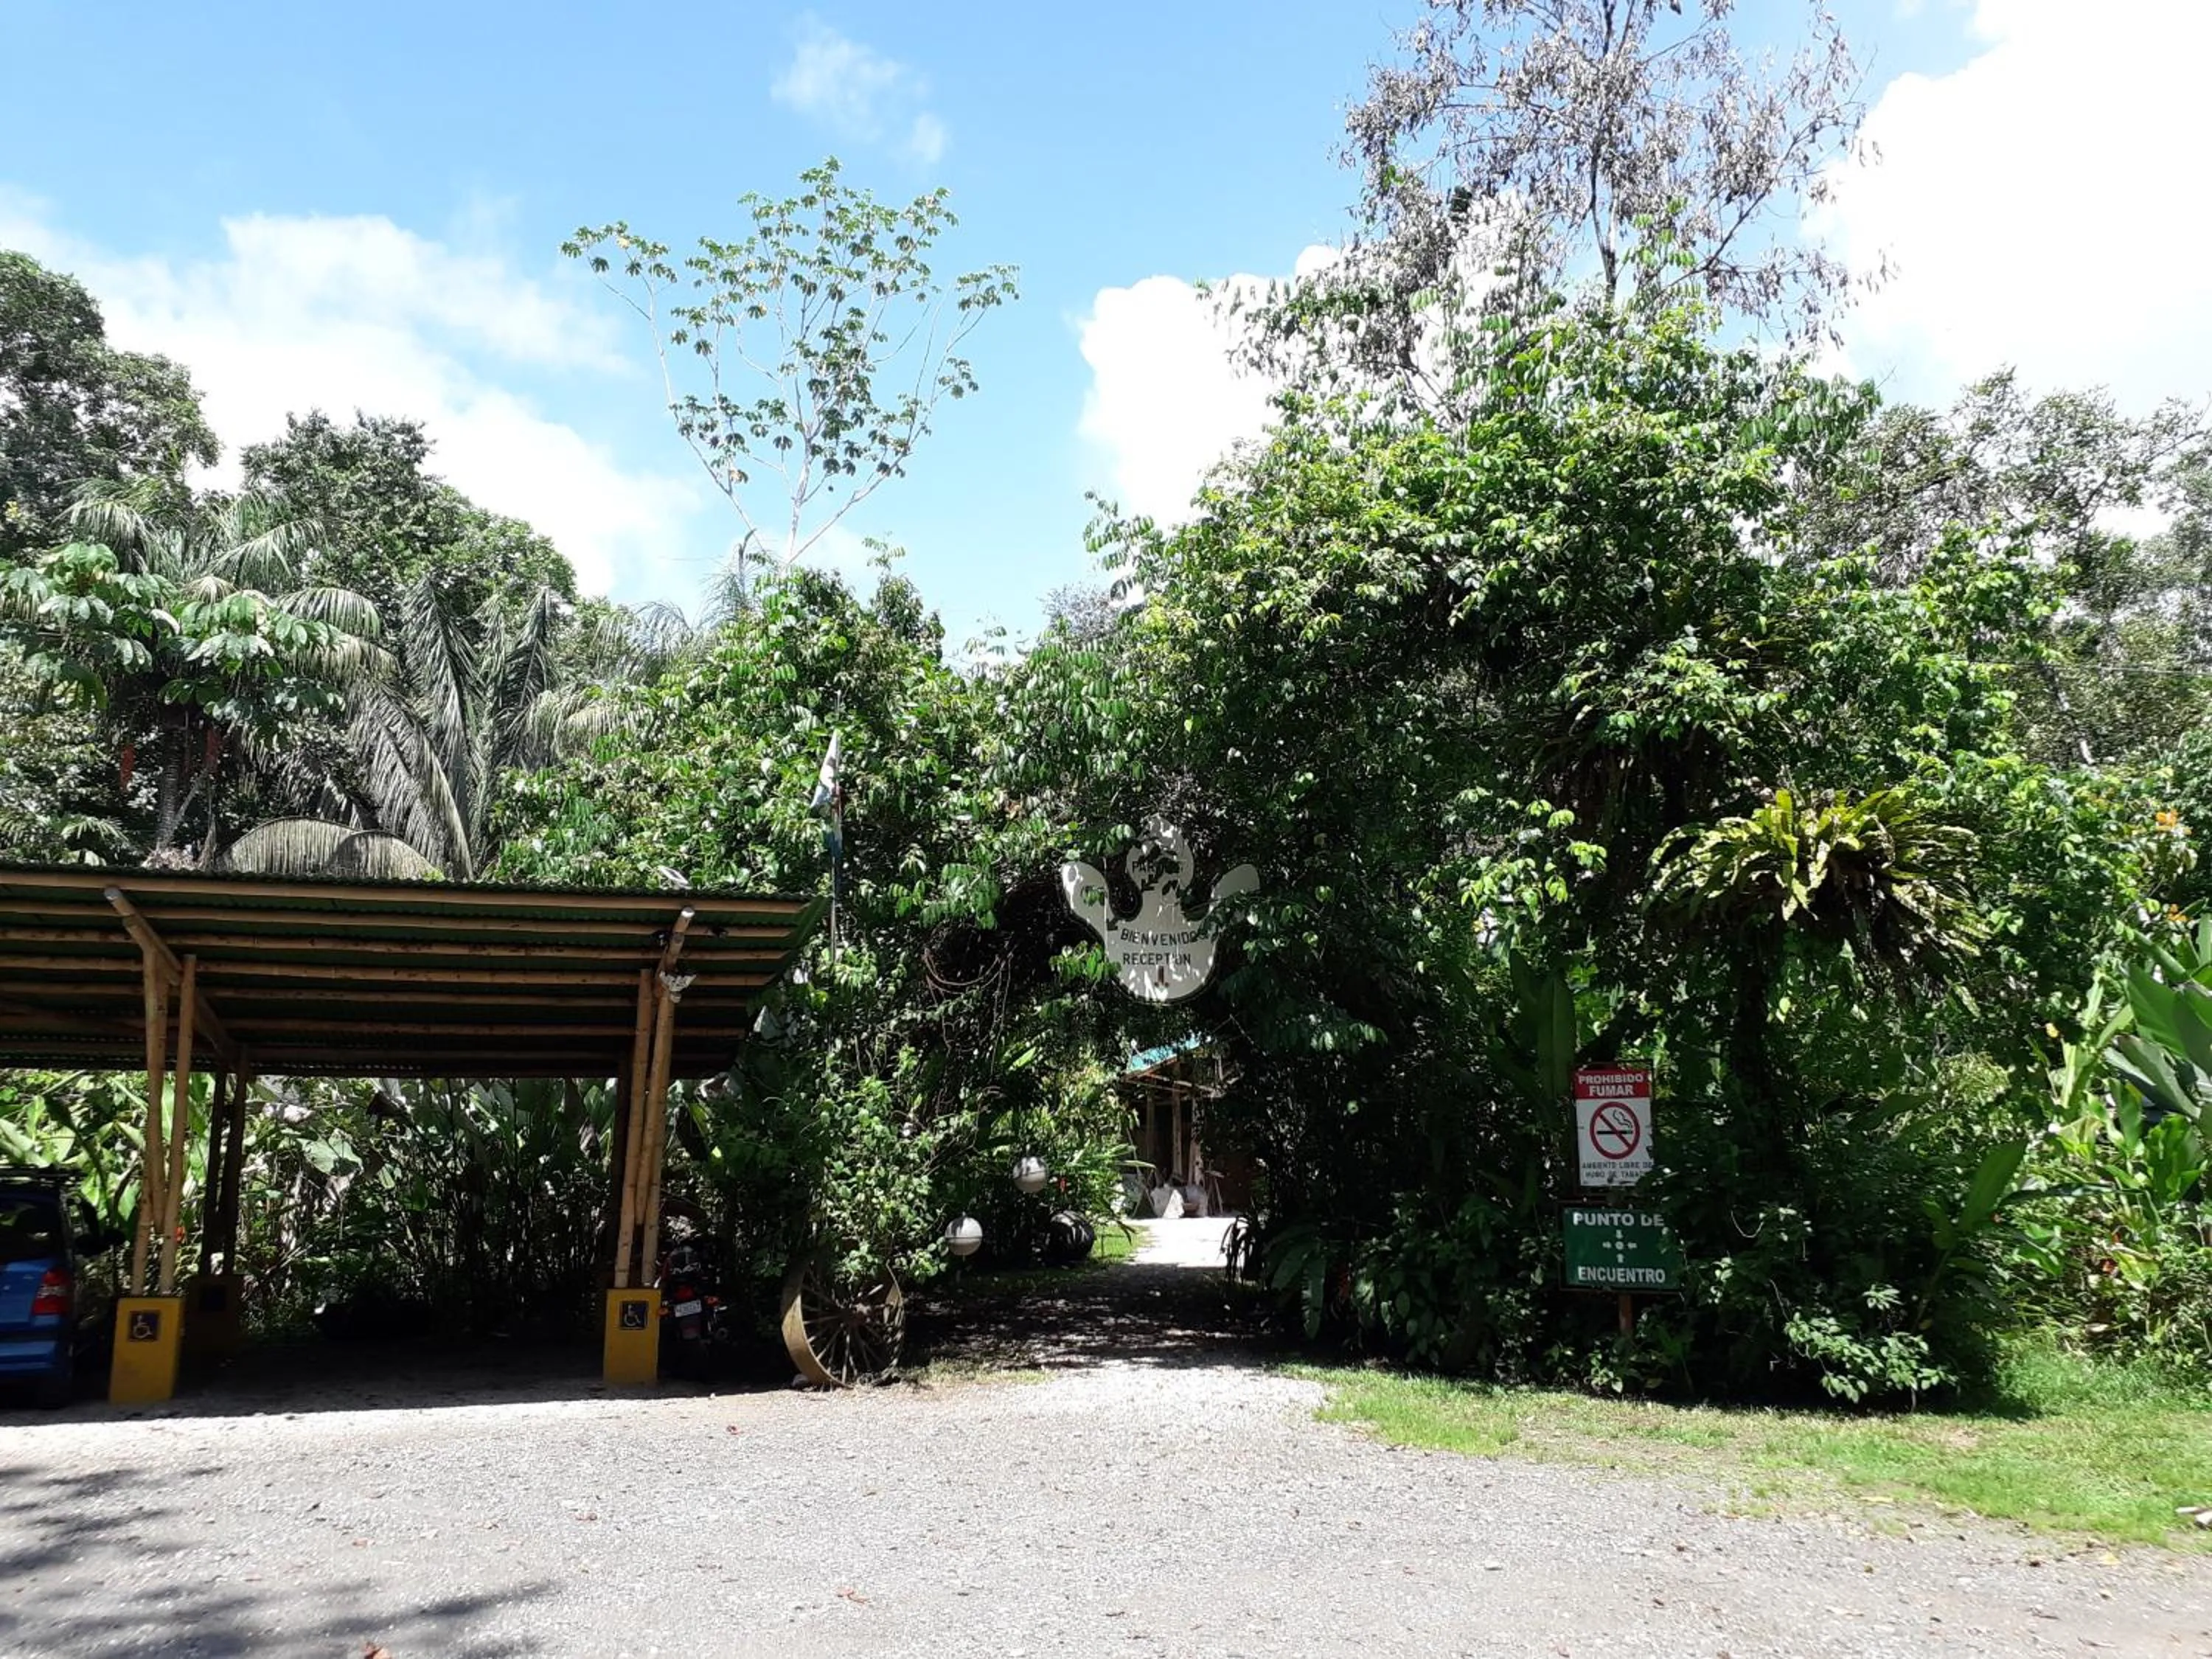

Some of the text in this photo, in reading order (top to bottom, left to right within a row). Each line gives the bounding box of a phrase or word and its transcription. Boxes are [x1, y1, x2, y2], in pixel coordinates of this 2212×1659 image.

[1578, 1074, 1644, 1085] PROHIBIDO
[1589, 1085, 1634, 1096] FUMAR
[1573, 1212, 1664, 1226] PUNTO DE
[1577, 1266, 1666, 1283] ENCUENTRO
